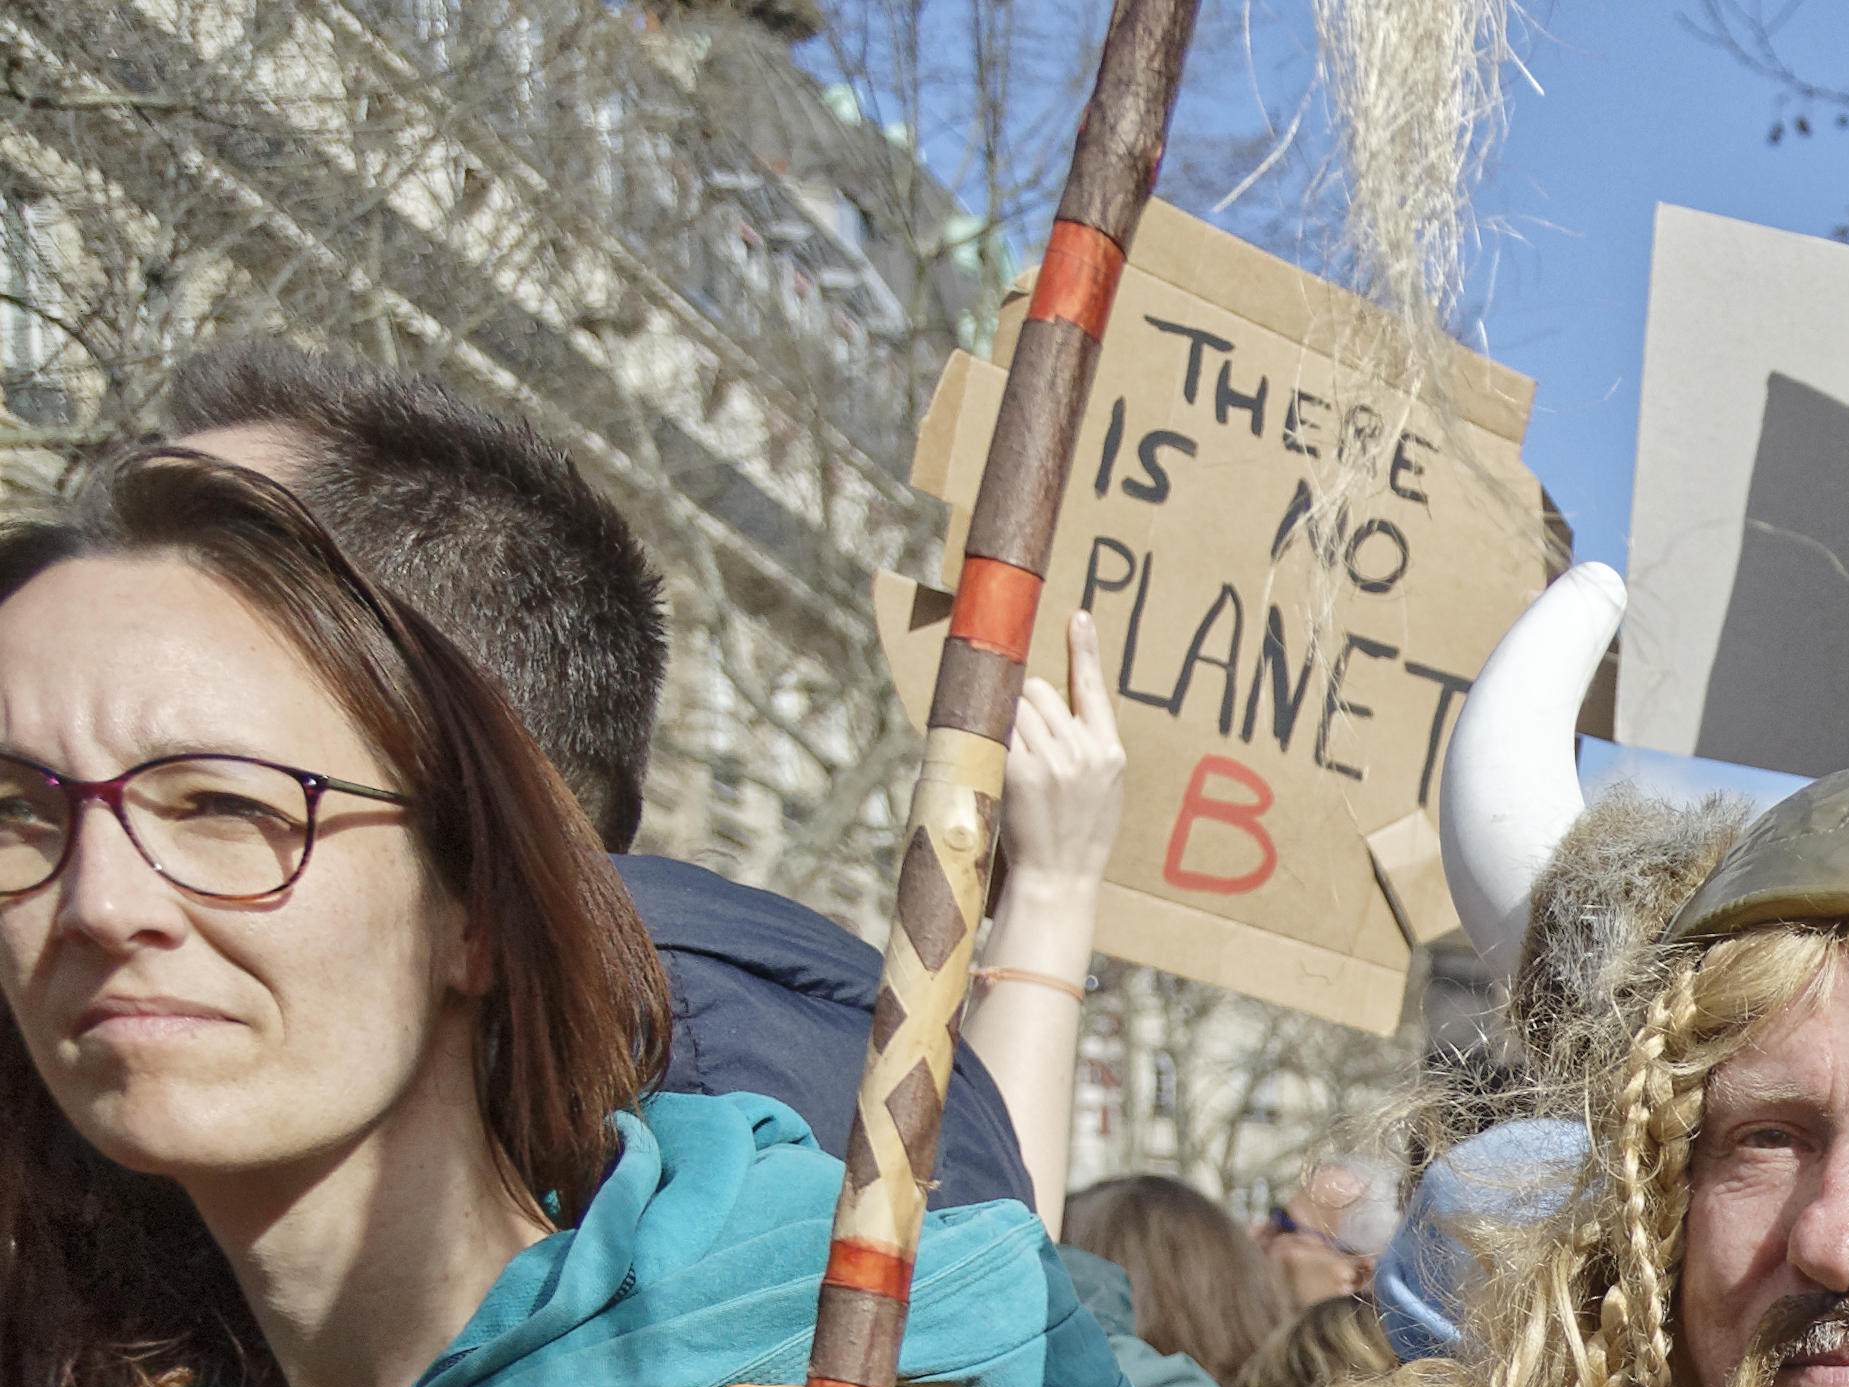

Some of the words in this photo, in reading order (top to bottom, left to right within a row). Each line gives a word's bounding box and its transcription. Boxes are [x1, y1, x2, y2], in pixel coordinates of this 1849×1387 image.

[1095, 397, 1197, 504] IS
[1270, 476, 1411, 593] NO
[1144, 315, 1440, 504] THERE
[1081, 537, 1470, 806] PLANET
[1163, 755, 1277, 895] B
